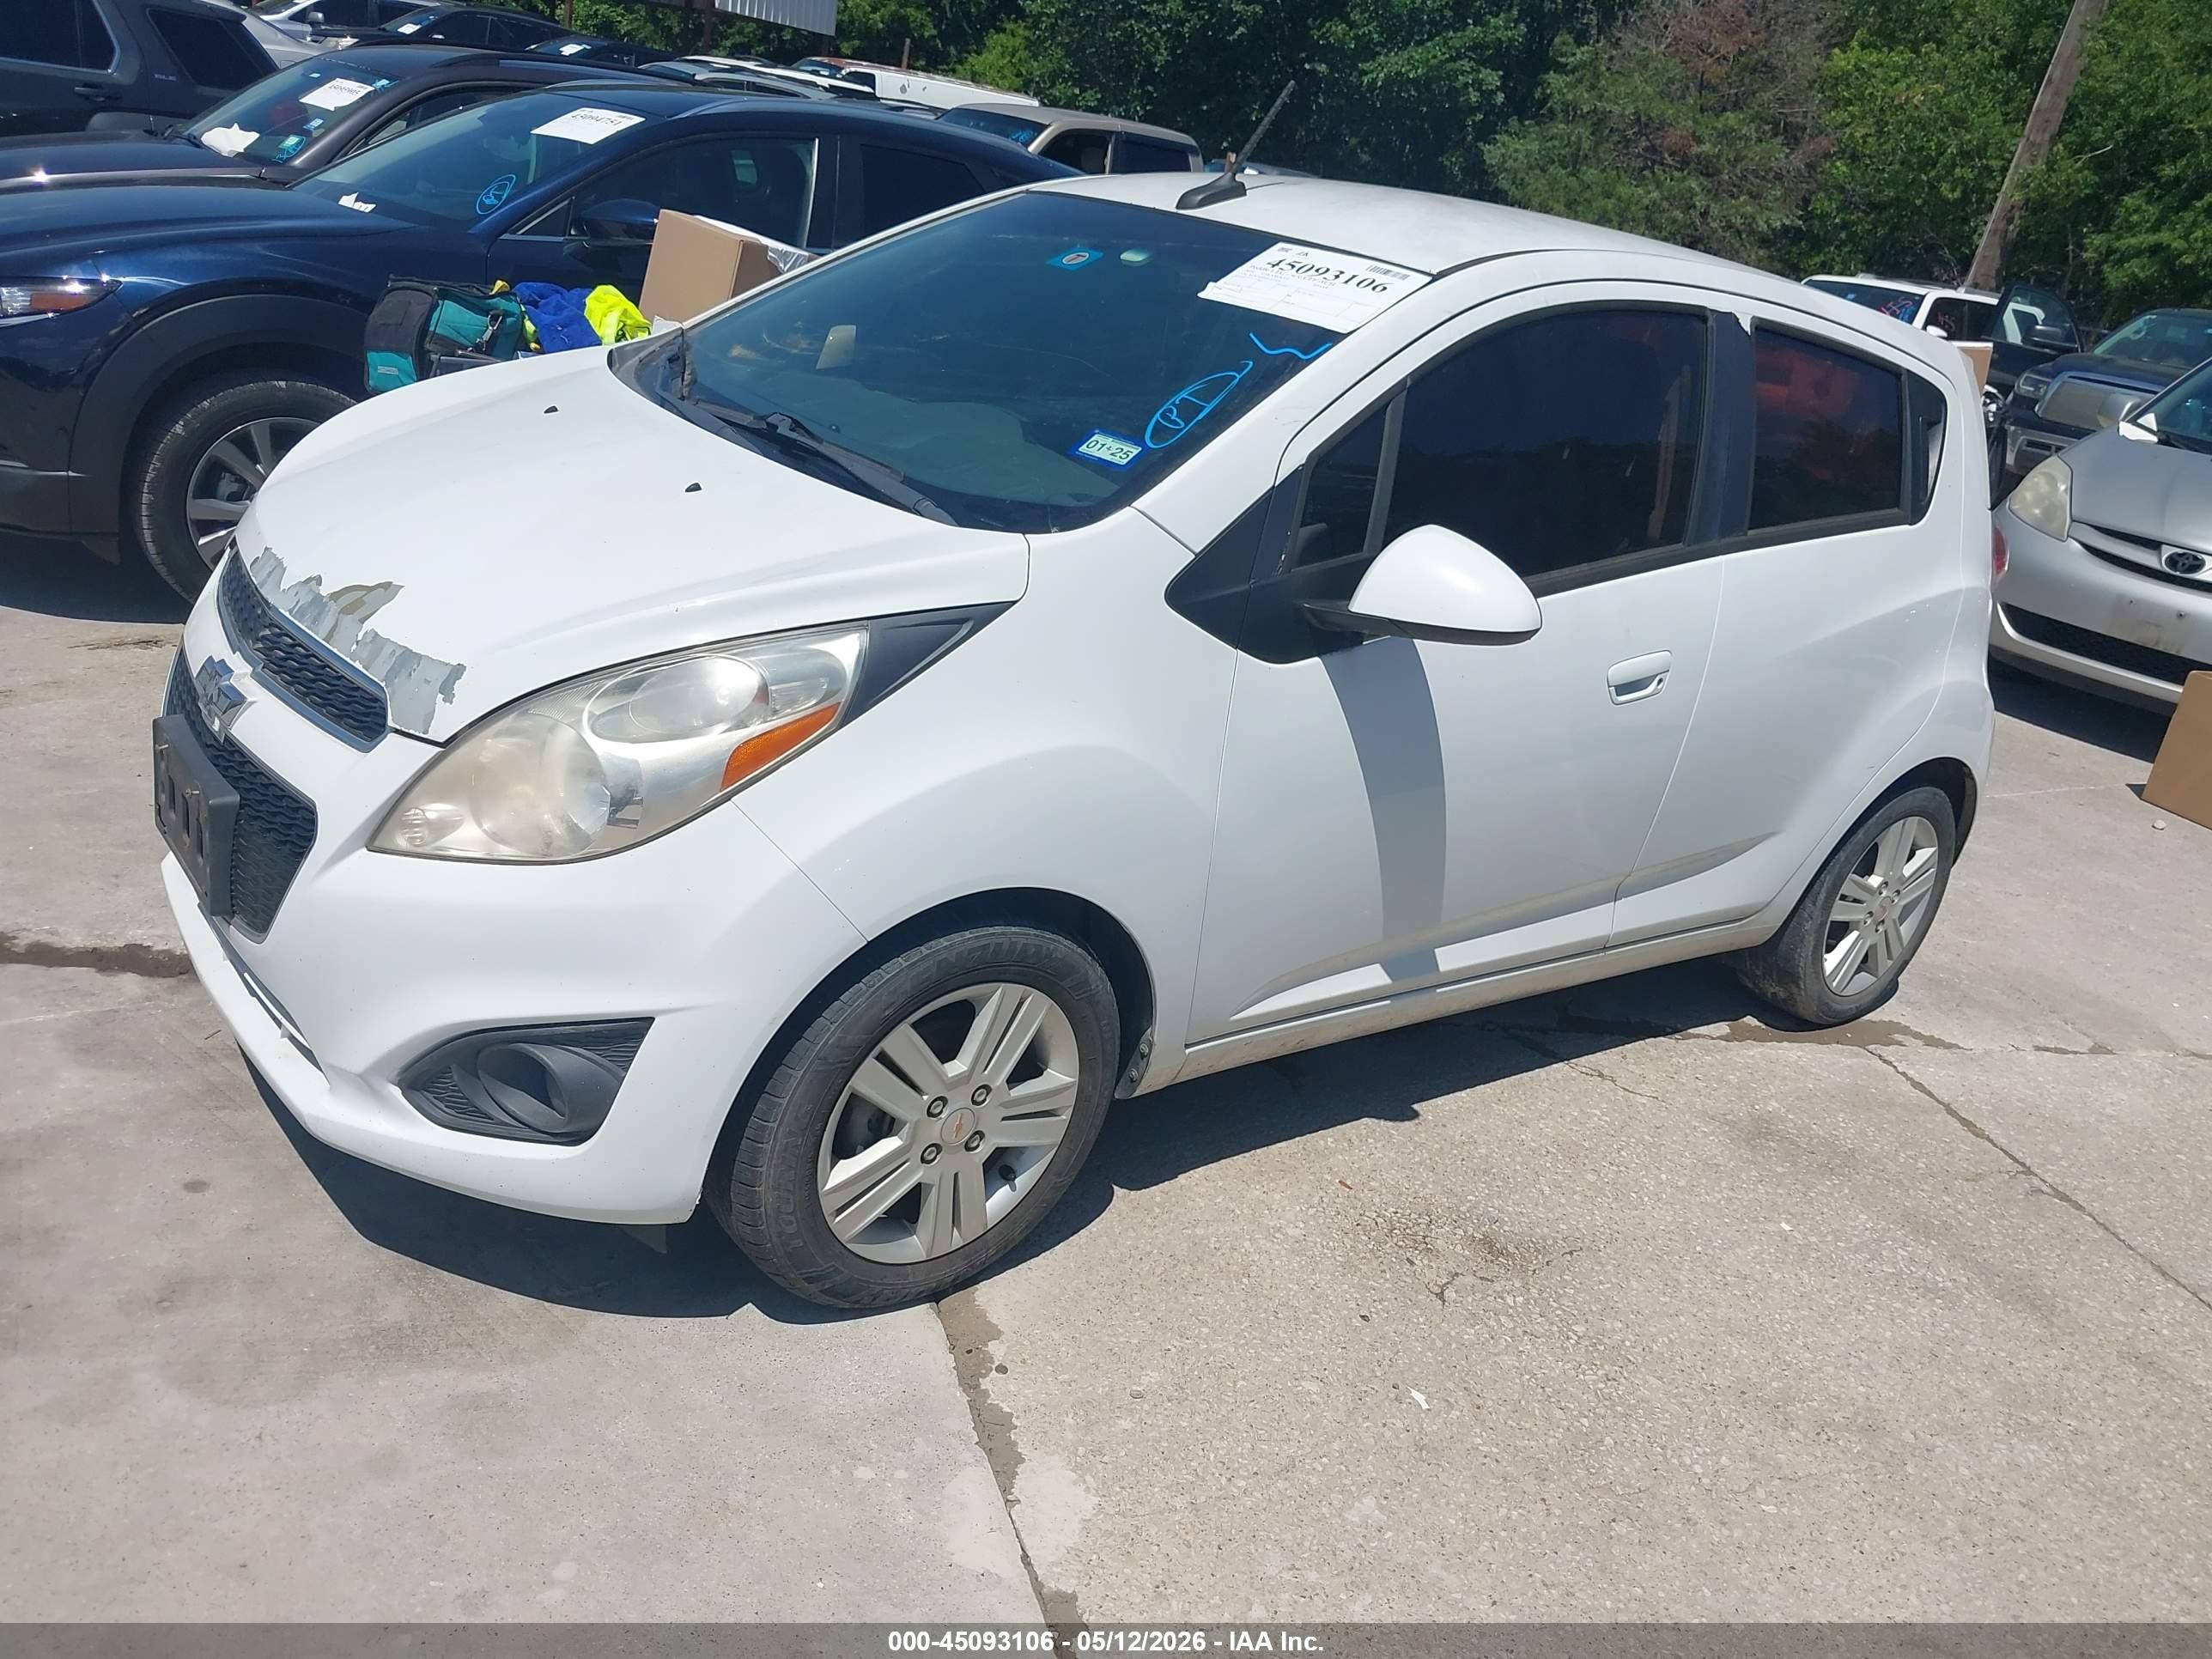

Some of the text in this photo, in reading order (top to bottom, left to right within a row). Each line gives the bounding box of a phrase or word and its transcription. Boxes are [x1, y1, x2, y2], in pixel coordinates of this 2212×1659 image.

[1266, 258, 1395, 294] 45093106
[1085, 440, 1134, 461] 01 25
